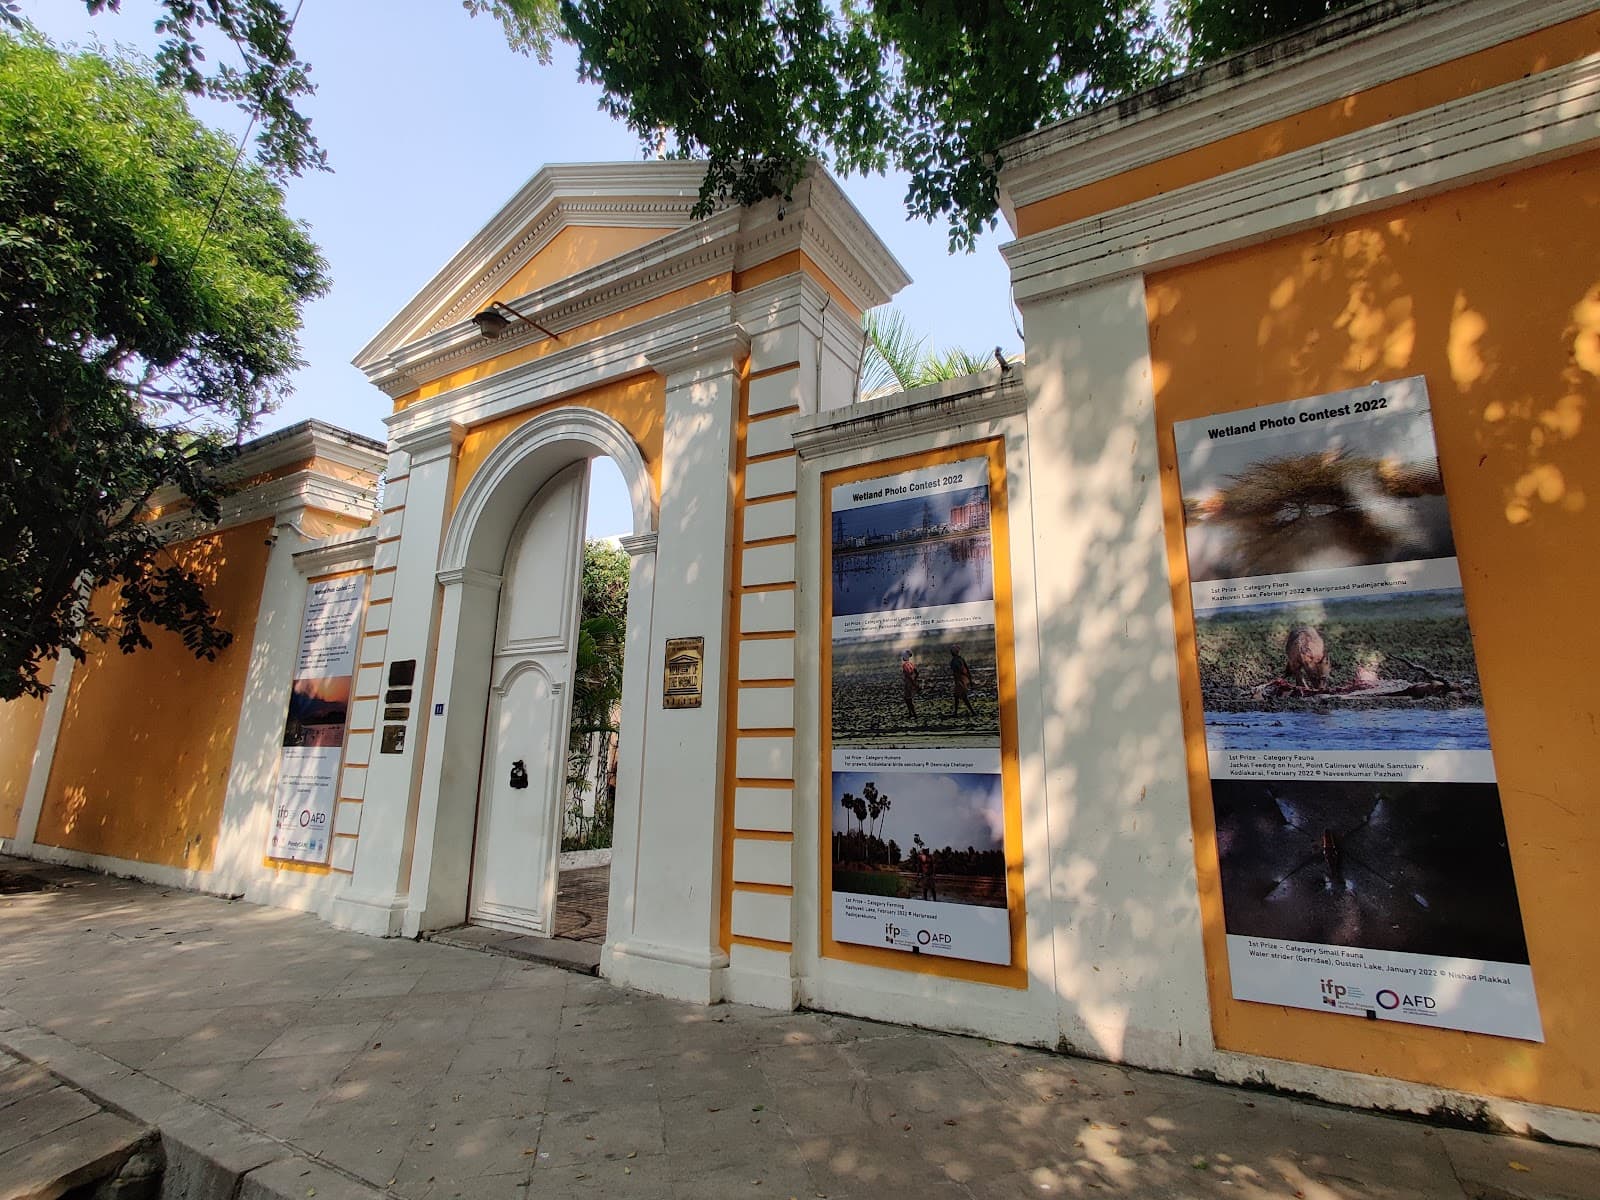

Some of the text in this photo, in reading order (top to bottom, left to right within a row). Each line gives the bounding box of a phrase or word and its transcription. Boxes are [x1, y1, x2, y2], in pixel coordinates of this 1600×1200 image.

[1208, 397, 1388, 440] Wetland Photo Contest 2022
[852, 473, 963, 502] Wetland Photo Contest 2022
[1263, 754, 1292, 762] Category
[1266, 770, 1297, 778] February
[310, 812, 326, 824] AFD
[885, 923, 901, 938] ifp
[931, 933, 952, 944] AFD
[1248, 940, 1260, 948] 1st
[1260, 941, 1278, 950] Prize
[1285, 944, 1317, 956] Category
[1318, 947, 1340, 957] Small
[1341, 949, 1364, 959] Fauna
[1249, 949, 1269, 958] Water
[1270, 952, 1293, 960] strider
[1363, 962, 1385, 972] Lake,
[1385, 965, 1417, 976] January
[1418, 968, 1438, 977] 2022
[1448, 971, 1477, 981] Nishad
[1320, 978, 1347, 999] ifp
[1402, 994, 1437, 1009] AFD
